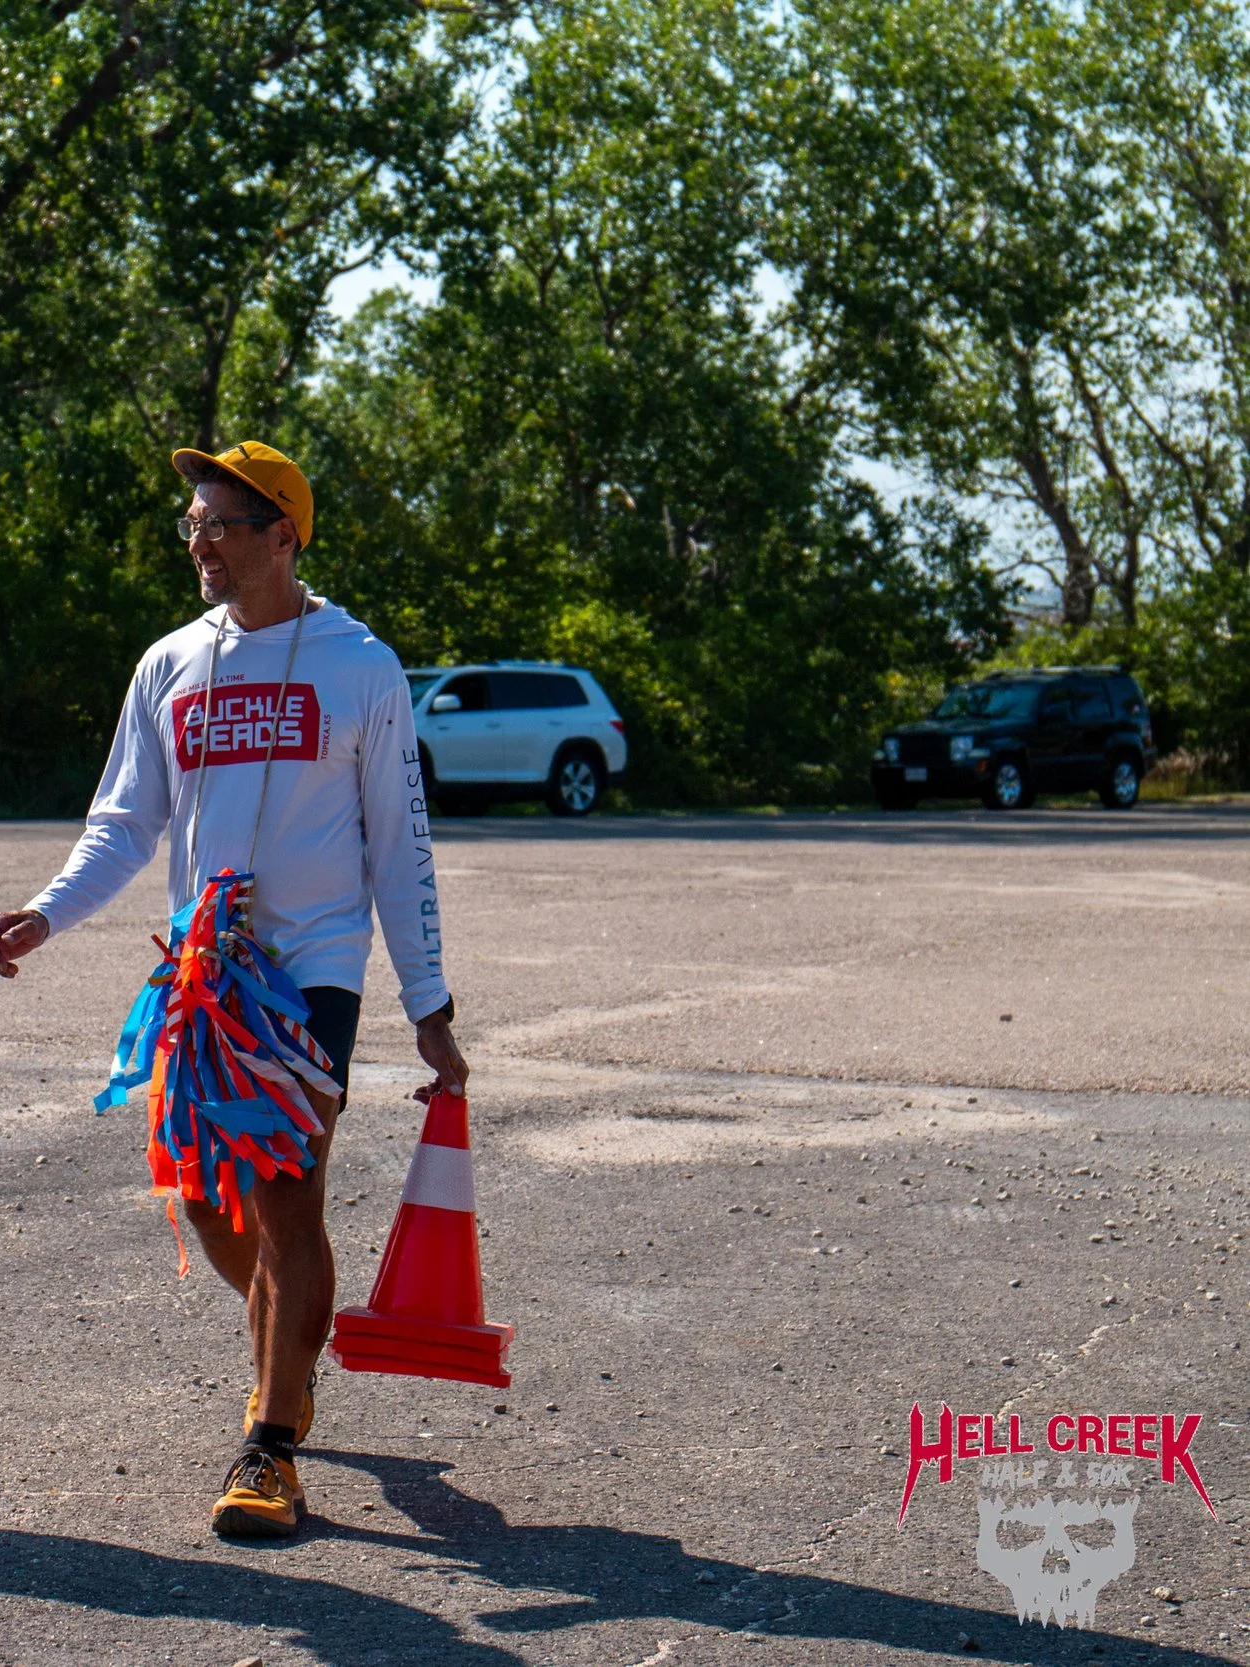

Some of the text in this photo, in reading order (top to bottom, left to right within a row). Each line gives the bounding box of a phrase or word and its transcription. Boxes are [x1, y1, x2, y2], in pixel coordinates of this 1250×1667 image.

[172, 688, 187, 698] ONE
[188, 681, 207, 692] MILE
[226, 673, 245, 682] TIME
[183, 696, 305, 726] BUCKLE
[323, 713, 332, 725] KS
[185, 720, 303, 757] HEADS
[403, 749, 443, 978] ULTRAVERSE
